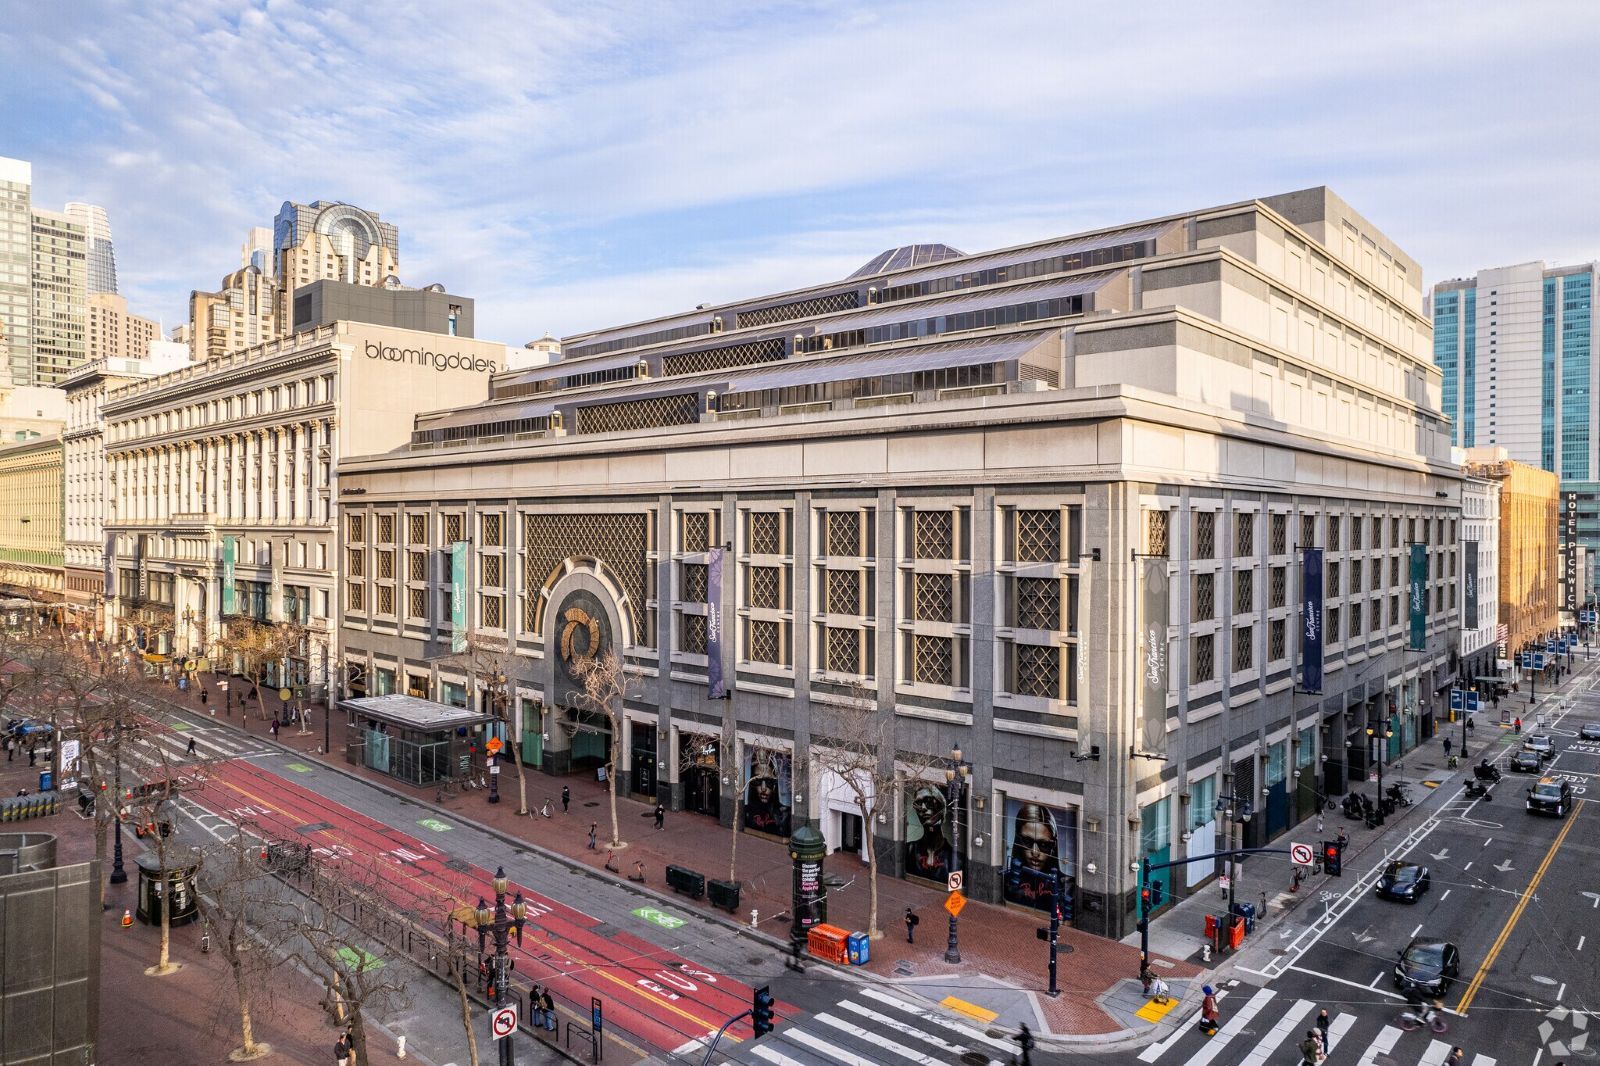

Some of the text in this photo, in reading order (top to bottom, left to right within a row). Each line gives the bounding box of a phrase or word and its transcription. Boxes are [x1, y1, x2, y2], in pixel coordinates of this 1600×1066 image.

[365, 339, 496, 374] bloomingdale's
[1567, 493, 1577, 610] HOTEL PICKWICK
[1147, 629, 1160, 684] San Francisco
[636, 963, 718, 1001] BUS
